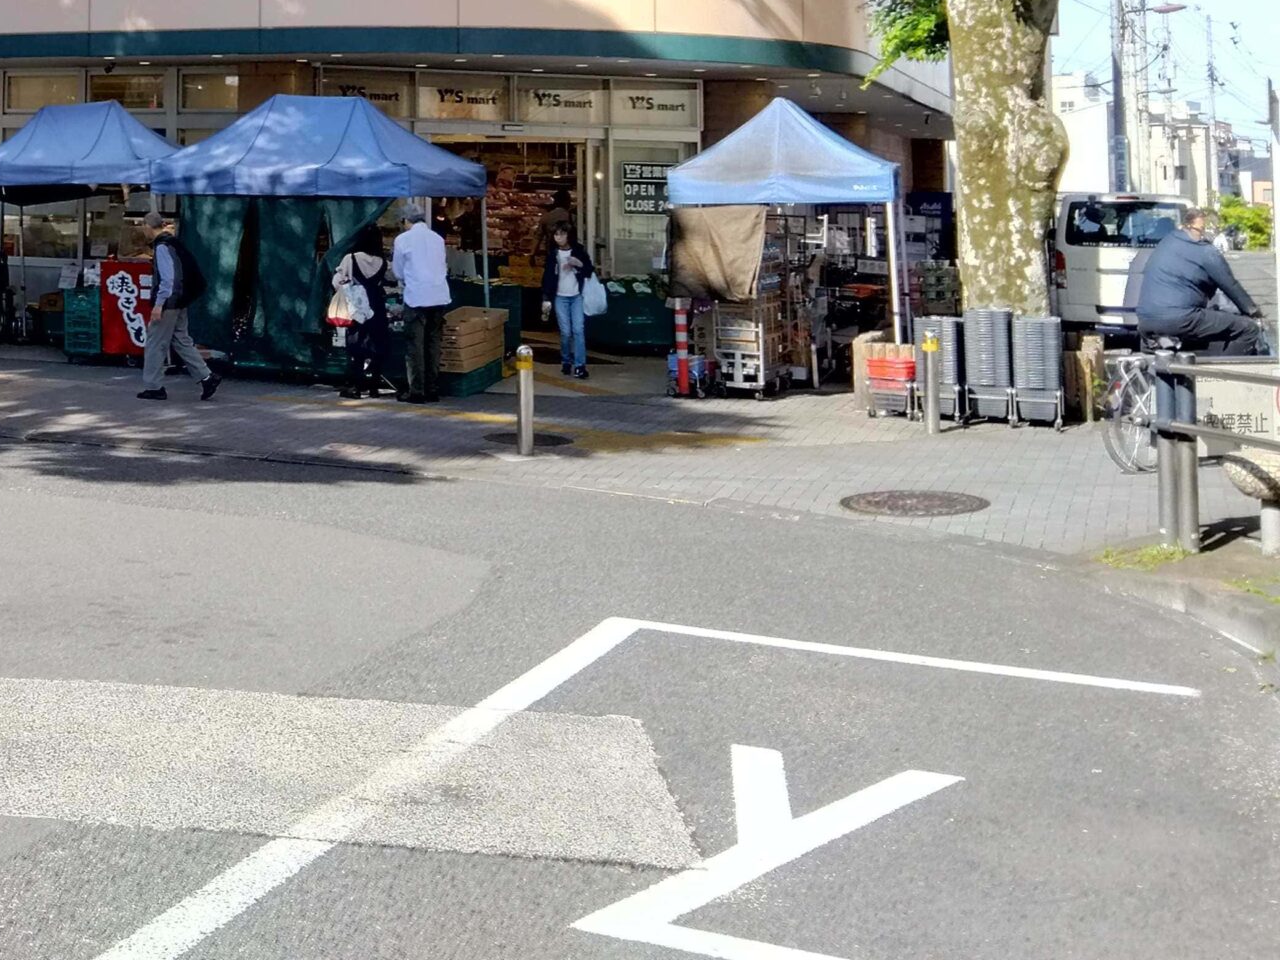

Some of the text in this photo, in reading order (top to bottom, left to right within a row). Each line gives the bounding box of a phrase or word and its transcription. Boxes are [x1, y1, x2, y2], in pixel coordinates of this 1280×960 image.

[370, 92, 400, 102] mart
[467, 96, 497, 106] mart
[564, 98, 593, 109] mart
[657, 102, 686, 112] mart
[624, 184, 655, 196] OPEN
[624, 200, 655, 211] CLOSE
